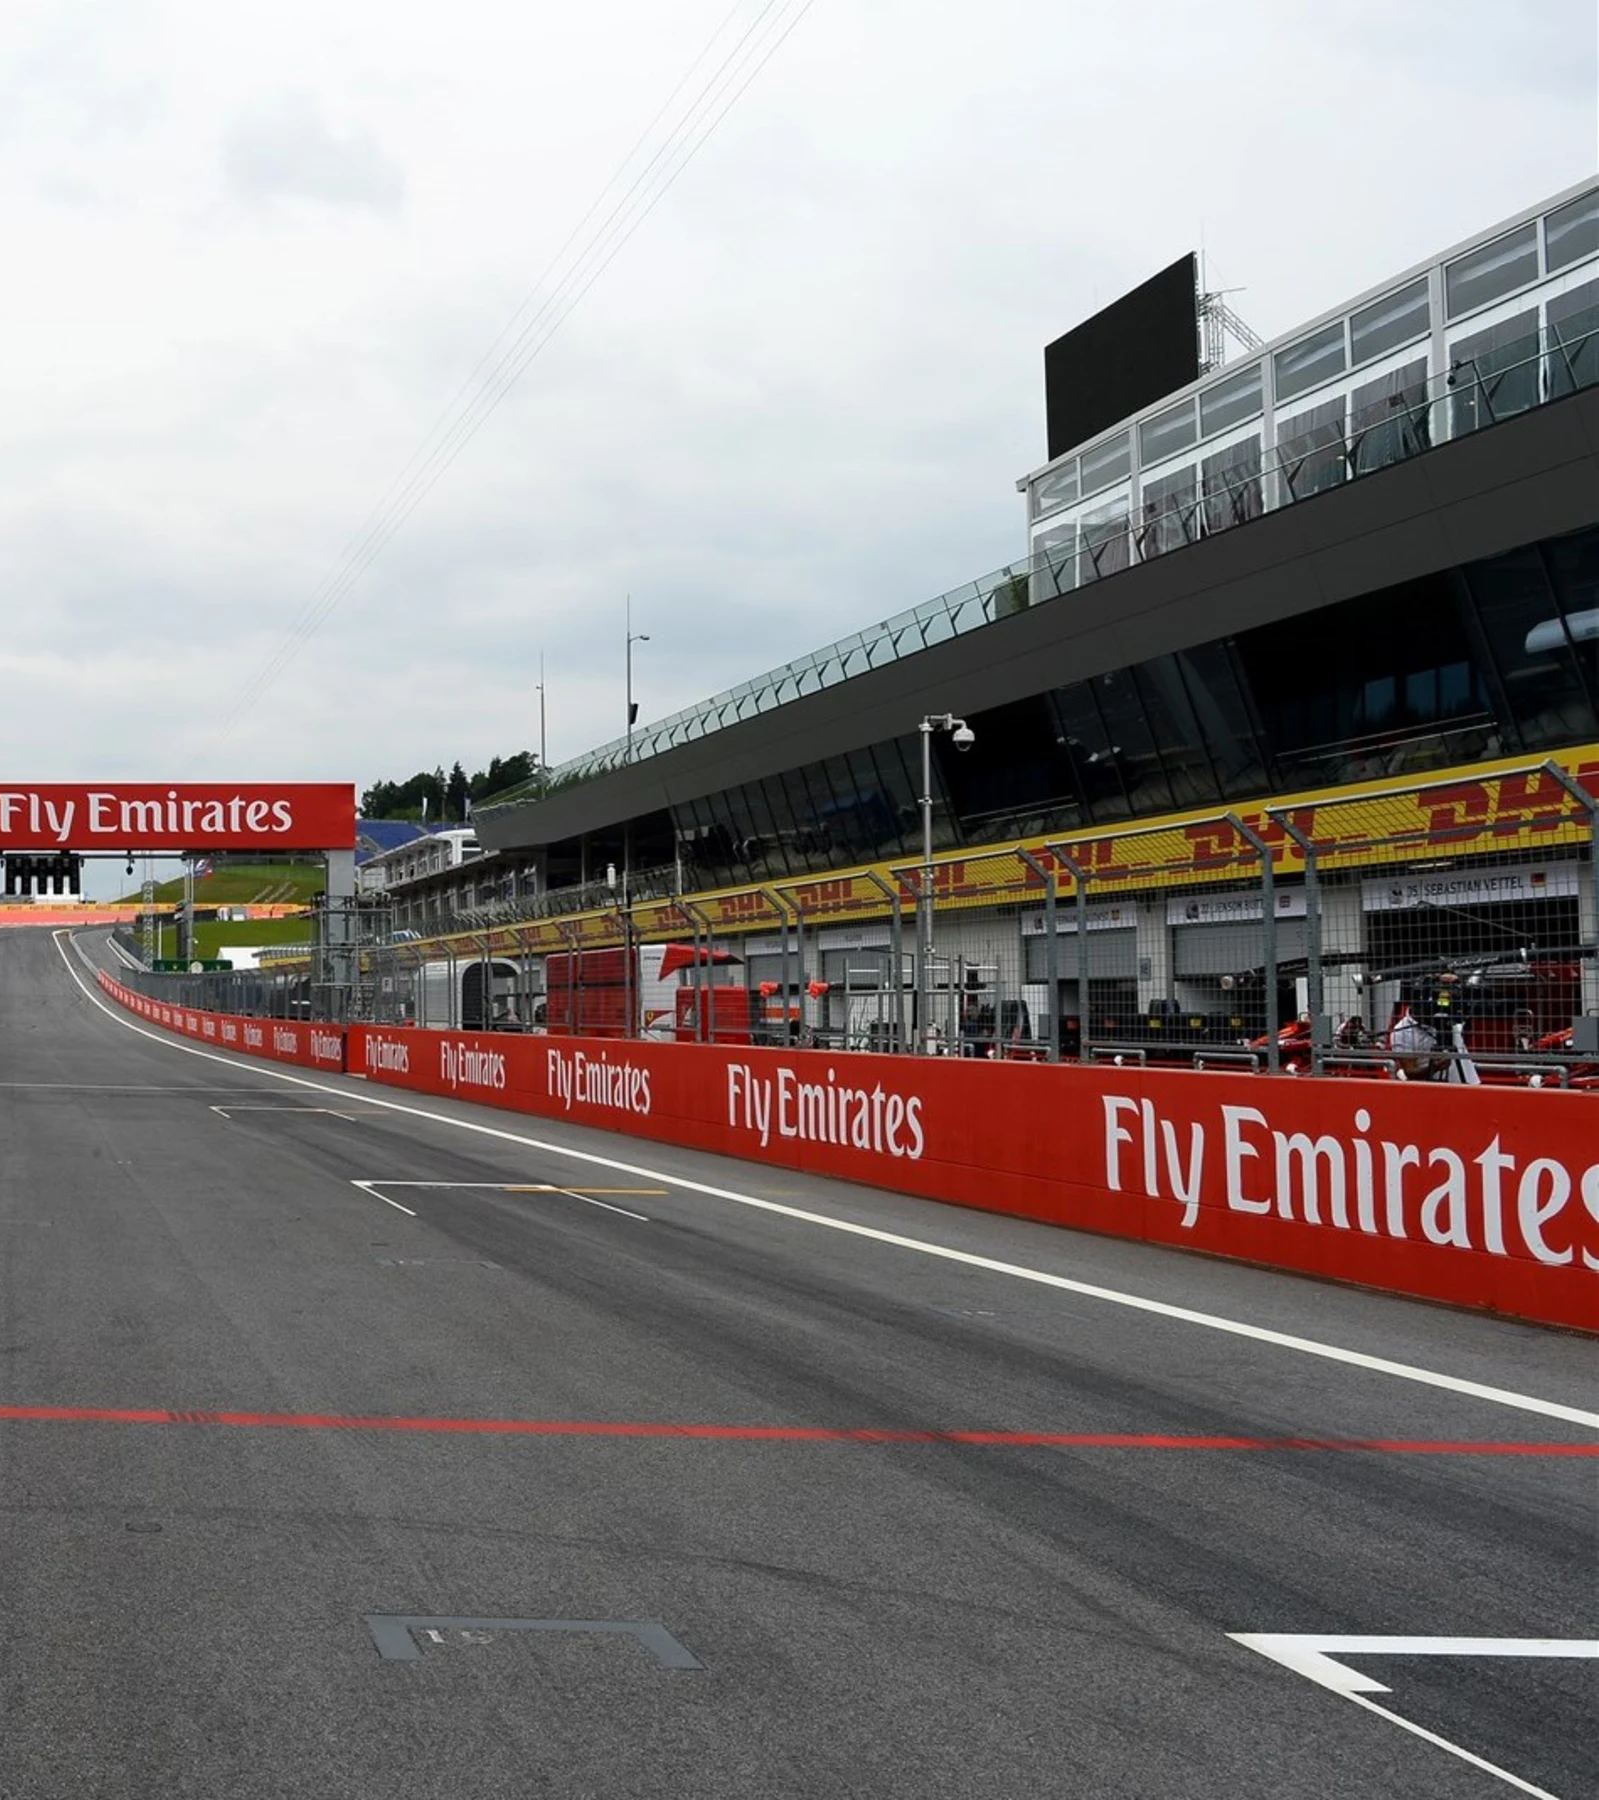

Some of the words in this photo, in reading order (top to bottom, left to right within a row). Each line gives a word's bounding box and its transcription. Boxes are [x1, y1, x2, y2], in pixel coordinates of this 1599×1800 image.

[87, 790, 292, 834] Emirates
[1183, 808, 1337, 870] DHL
[366, 1034, 378, 1074] Fly
[377, 1034, 409, 1073] Emirates
[440, 1041, 457, 1089] Fly
[457, 1041, 506, 1089] Emirates
[547, 1048, 573, 1111] Fly
[574, 1050, 651, 1115] Emirates
[727, 1063, 771, 1147] Fly
[776, 1067, 924, 1160] Emirates
[1101, 1095, 1205, 1228] Fly
